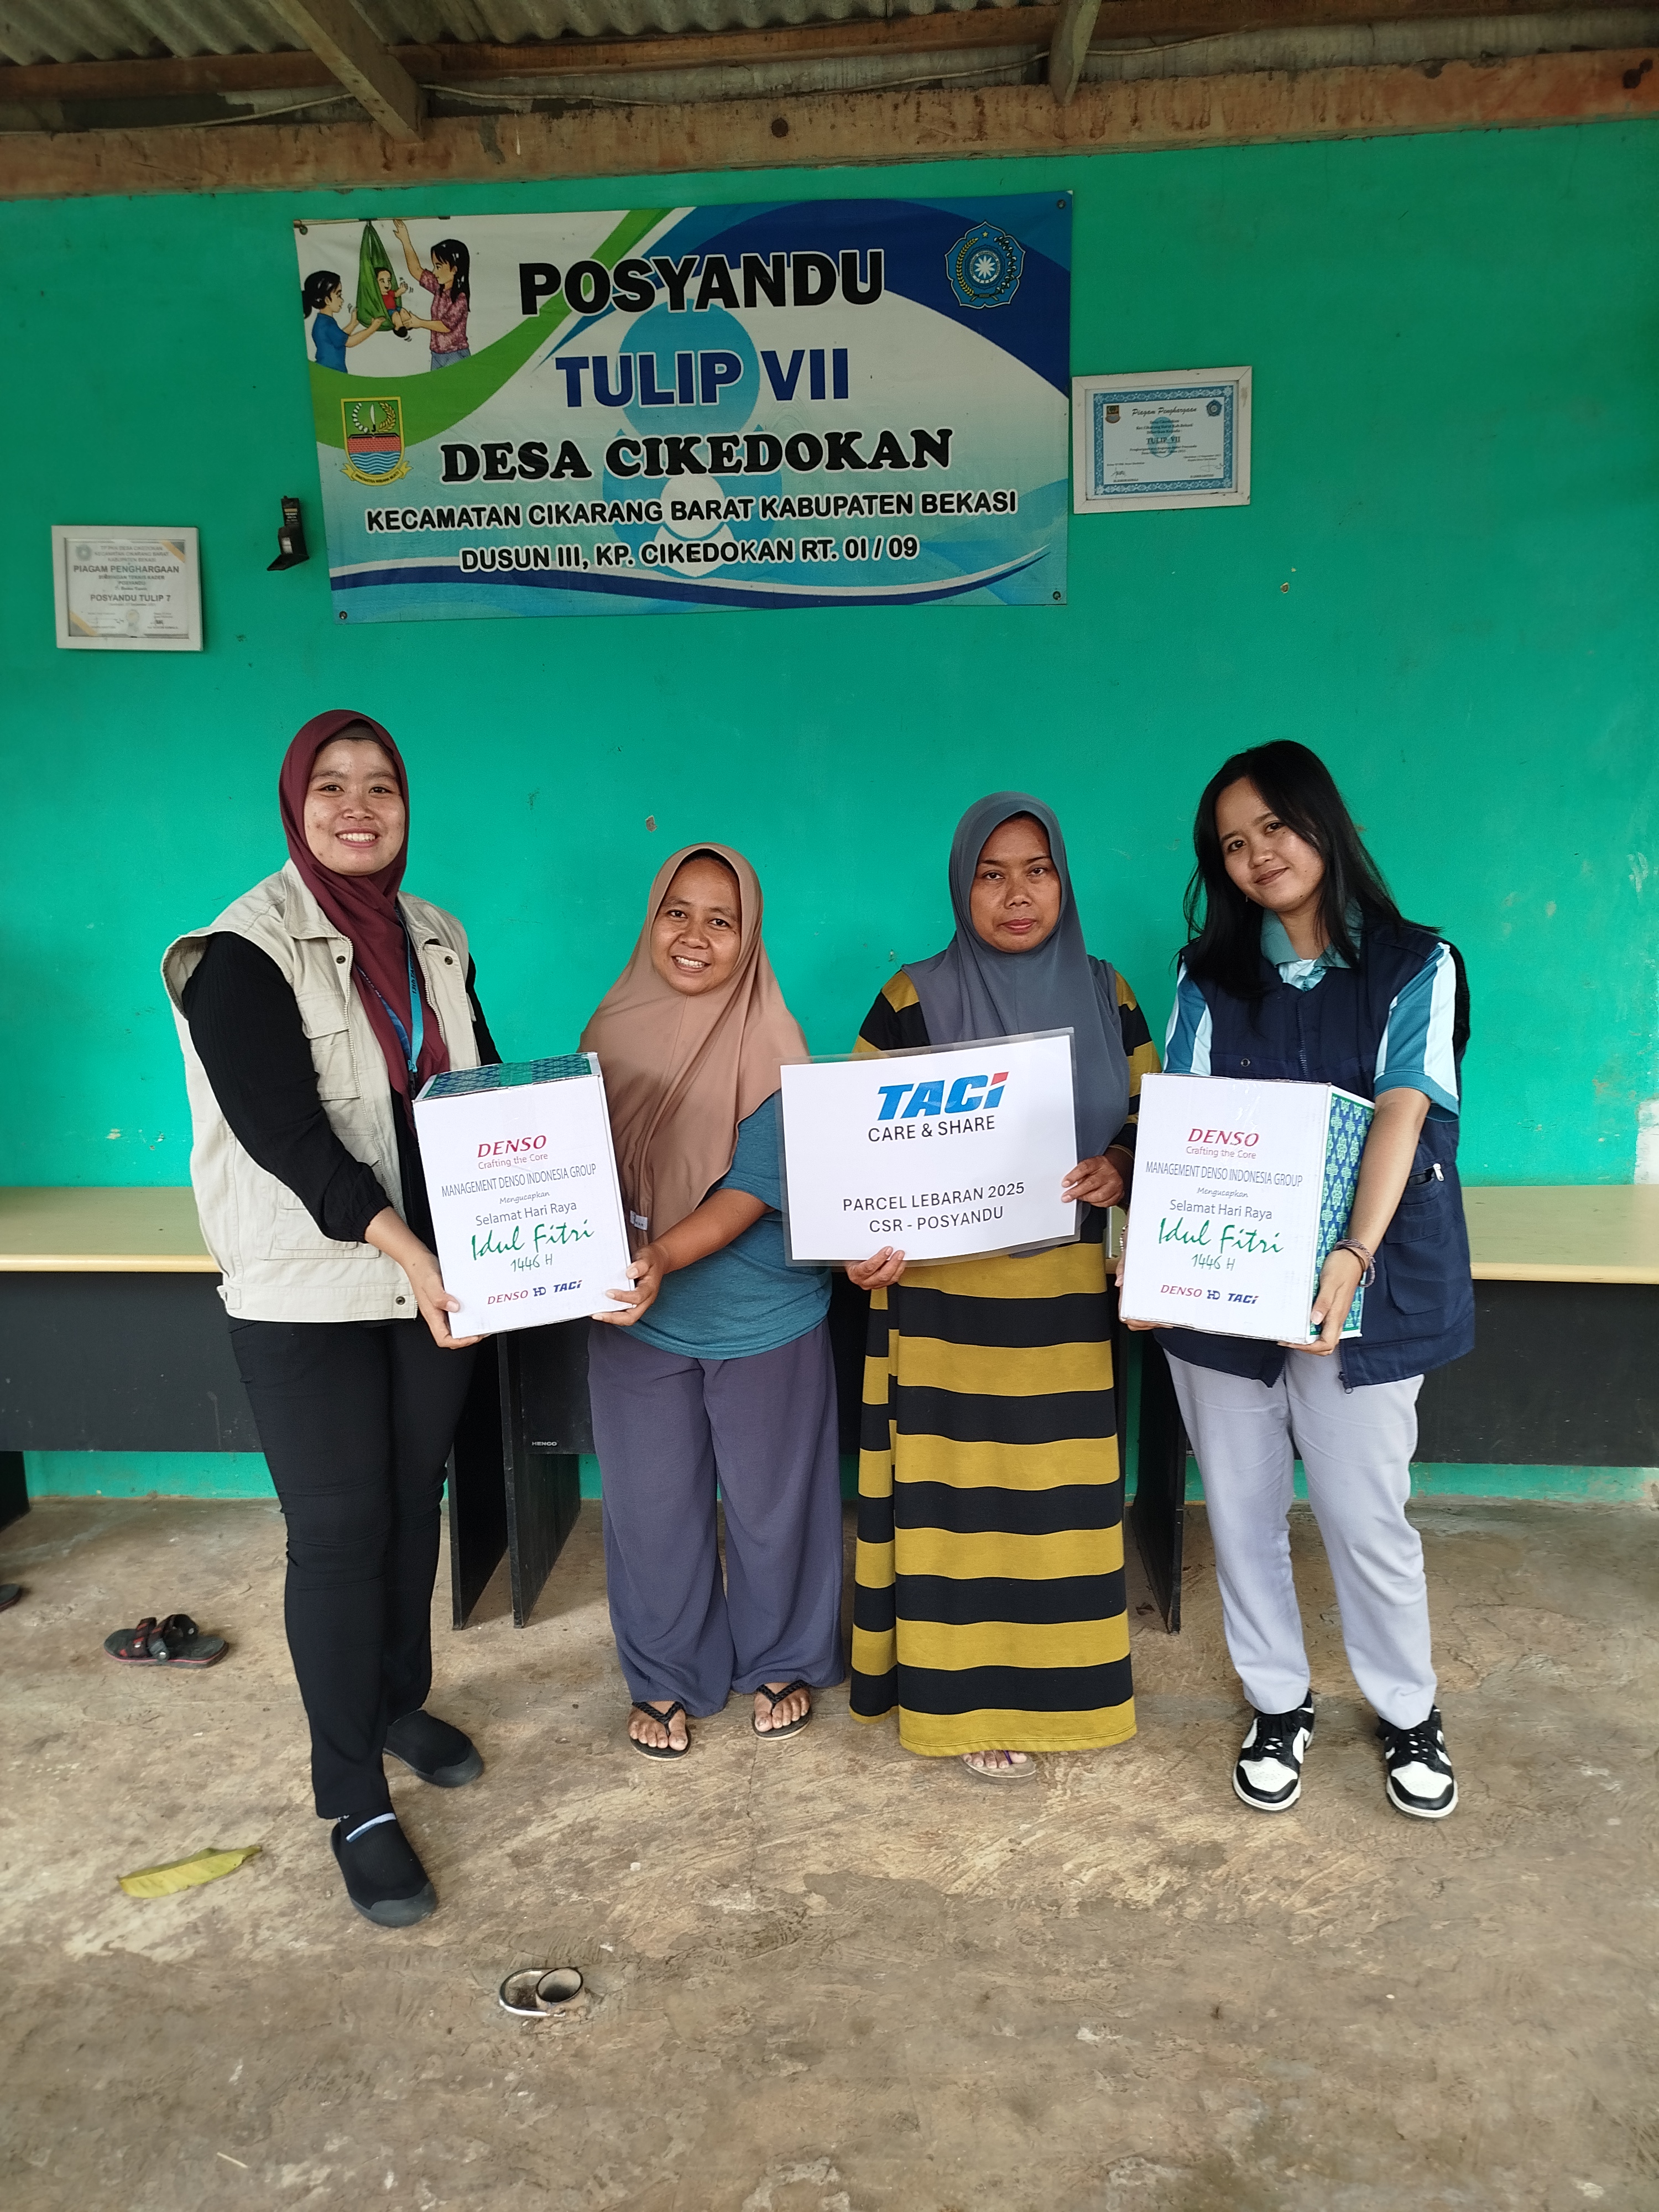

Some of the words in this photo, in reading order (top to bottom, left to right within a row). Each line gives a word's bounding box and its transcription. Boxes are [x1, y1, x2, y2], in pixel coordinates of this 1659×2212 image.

[519, 250, 884, 315] POSYANDU
[556, 352, 742, 407] TULIP
[761, 348, 849, 401] VII
[1132, 408, 1155, 417] Piagam
[1157, 406, 1197, 415] Penghargaan
[441, 441, 592, 482] DESA
[606, 429, 952, 477] CIKEDOKAN
[367, 507, 521, 531] KECAMATAN
[529, 502, 662, 526] CIKARANG
[671, 499, 753, 520] BARAT
[761, 493, 912, 518] KABUPATEN
[922, 492, 1015, 514] BEKASI
[462, 547, 549, 571] DUSUN
[558, 546, 588, 571] III,
[597, 545, 633, 566] KP.
[641, 541, 793, 564] CIKEDOKAN
[802, 539, 837, 560] RT.
[888, 537, 918, 557] 09
[868, 1125, 916, 1141] CARE
[922, 1123, 933, 1137] &
[938, 1115, 995, 1135] SHARE
[1187, 1128, 1260, 1146] DENSO
[477, 1135, 546, 1157] DENSO
[1186, 1146, 1218, 1157] Crafting
[1238, 1150, 1256, 1159] Core
[478, 1159, 511, 1169] Crafting
[1146, 1161, 1201, 1177] MANAGEMENT
[1201, 1166, 1228, 1180] DENSO
[1229, 1168, 1272, 1185] INDONESIA
[1274, 1173, 1303, 1187] GROUP
[442, 1178, 497, 1197] MANAGEMENT
[499, 1174, 525, 1188] DENSO
[526, 1168, 569, 1185] INDONESIA
[570, 1164, 596, 1177] GROUP
[1197, 1187, 1249, 1198] Mengucapkan
[499, 1191, 550, 1204] Mengucapkan
[843, 1196, 907, 1211] PARCEL
[912, 1187, 983, 1208] LEBARAN
[988, 1182, 1025, 1198] 2025
[476, 1210, 522, 1226] Selamat
[524, 1205, 547, 1218] Hari
[550, 1202, 577, 1215] Raya
[869, 1219, 902, 1232] CSR
[917, 1206, 1003, 1230] POSYANDU
[1170, 1199, 1215, 1214] Selamat
[1218, 1204, 1242, 1217] Hari
[1245, 1207, 1272, 1222] Raya
[472, 1225, 525, 1260] Idul
[533, 1219, 594, 1253] Fitri
[1159, 1217, 1212, 1245] Idul
[1220, 1224, 1284, 1254] Fitri
[510, 1254, 540, 1272] 1446
[545, 1253, 552, 1266] H
[1191, 1253, 1222, 1270] 1446
[1226, 1258, 1236, 1271] H
[487, 1290, 529, 1305] DENSO
[1160, 1285, 1202, 1297] DENSO
